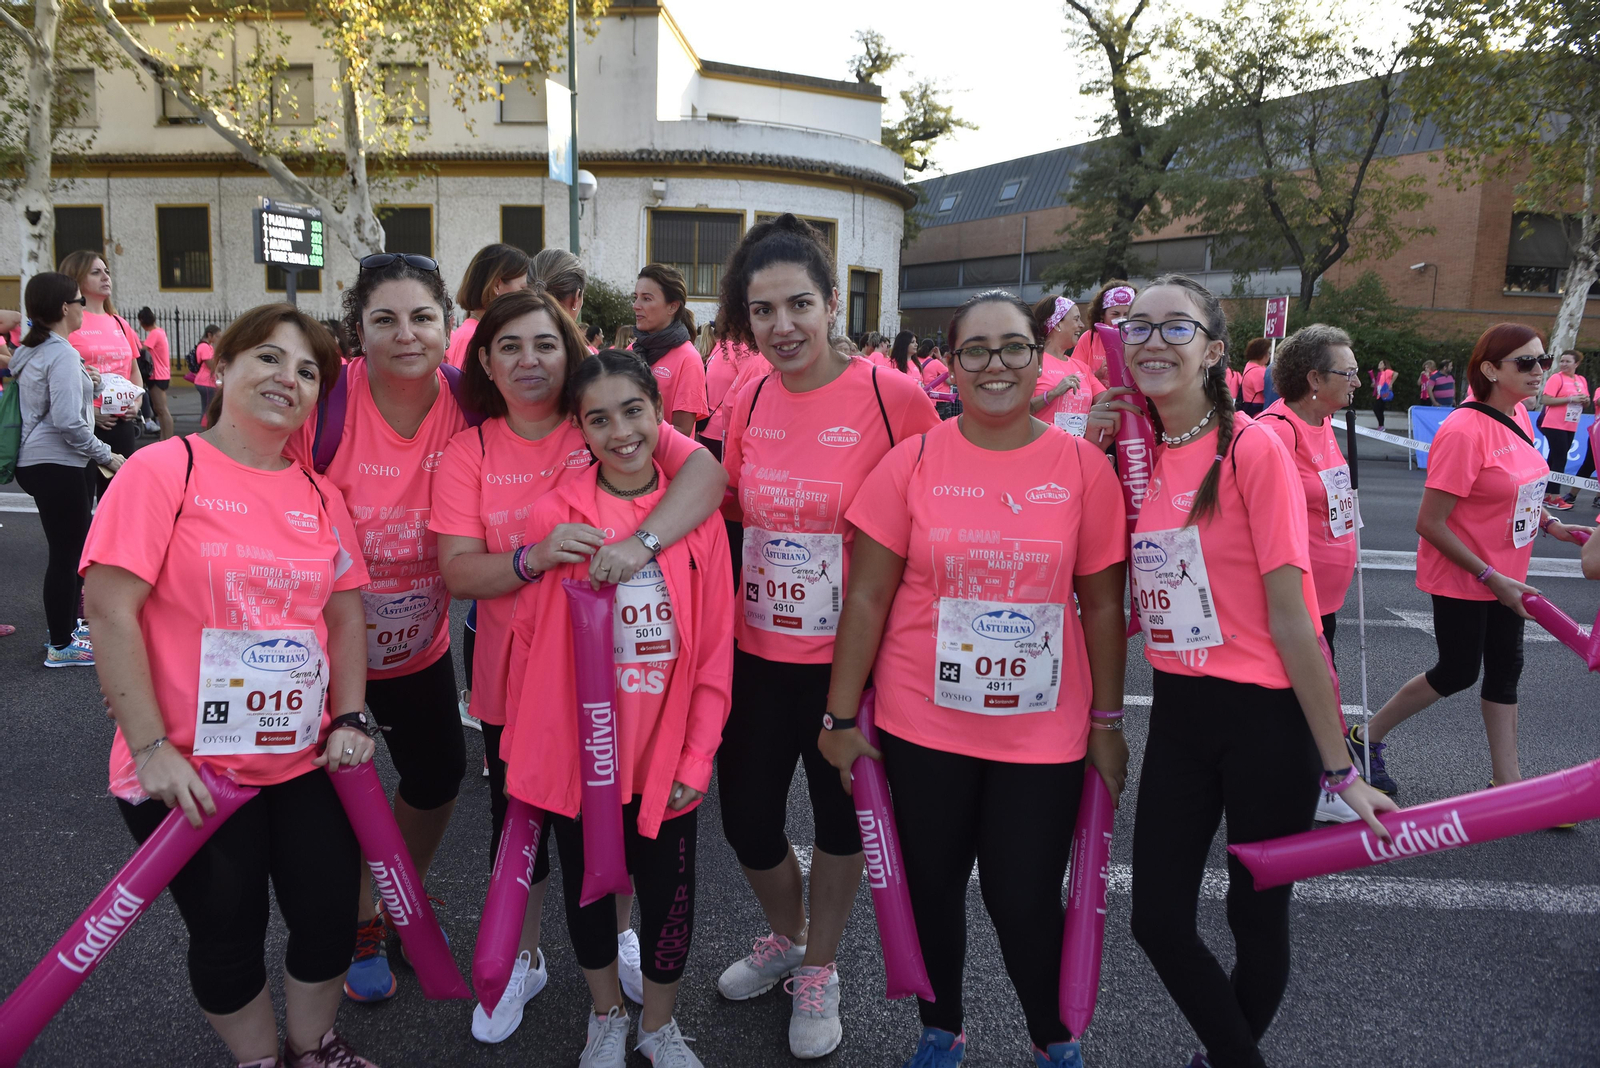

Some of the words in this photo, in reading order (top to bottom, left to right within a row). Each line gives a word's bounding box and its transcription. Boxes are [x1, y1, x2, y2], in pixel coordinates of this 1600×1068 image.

[263, 198, 270, 209] P
[268, 213, 286, 227] PLAZA
[269, 226, 303, 242] MAGDALENA
[270, 250, 288, 263] TORRE
[288, 252, 309, 265] SEVILLA
[1268, 301, 1277, 314] SUB
[116, 391, 135, 400] 016
[750, 427, 786, 440] OYSHO
[821, 434, 858, 443] ASTURIANA
[1492, 443, 1518, 458] OYSHO
[486, 473, 533, 485] OYSHO
[755, 467, 790, 483] GANAN
[760, 485, 788, 497] VITORIA
[795, 490, 828, 503] GASTEIZ
[933, 485, 985, 498] OYSHO
[1030, 491, 1067, 500] ASTURIANA
[194, 495, 248, 514] OYSHO
[773, 496, 805, 508] MADRID
[1339, 497, 1353, 511] 016
[488, 510, 509, 526] HOY
[928, 528, 952, 542] HOY
[958, 529, 1001, 544] GANAN
[200, 542, 228, 557] HOY
[236, 543, 276, 562] GANAN
[765, 547, 806, 560] ASTURIANA
[969, 549, 1004, 560] VITORIA
[1013, 552, 1050, 563] GASTEIZ
[988, 560, 1024, 570] MADRID
[1133, 554, 1164, 564] ASTURIANA
[250, 566, 283, 578] VITORIA
[291, 569, 321, 581] GASTEIZ
[791, 567, 814, 575] Carrera
[1155, 571, 1174, 579] Carrera
[267, 578, 300, 590] MADRID
[373, 578, 398, 588] CORUÑA
[766, 580, 806, 601] 016
[1140, 589, 1171, 610] 016
[381, 602, 427, 615] ASTURIANA
[621, 601, 673, 625] 016
[773, 603, 795, 613] 4910
[747, 610, 766, 621] OYSHO
[1149, 615, 1164, 625] 4909
[635, 627, 662, 638] 5010
[976, 619, 1031, 633] ASTURIANA
[377, 624, 420, 645] 016
[1186, 635, 1211, 643] ZURICH
[386, 642, 408, 654] 5014
[646, 643, 667, 651] Santander
[1014, 641, 1037, 649] Carrera
[247, 650, 305, 663] ASTURIANA
[975, 656, 1027, 677] 016
[986, 681, 1012, 691] 4911
[246, 690, 303, 711] 016
[941, 691, 972, 702] OYSHO
[259, 716, 290, 727] 5012
[203, 735, 241, 744] OYSHO
[583, 701, 615, 786] Ladival
[1361, 809, 1470, 862] Ladival
[856, 809, 887, 888] Ladival
[394, 854, 405, 871] SOLAR
[367, 861, 409, 926] Ladival
[412, 900, 424, 918] TRIPLE
[655, 884, 689, 970] FOREVER
[678, 837, 686, 873] UP
[57, 883, 145, 973] Ladival
